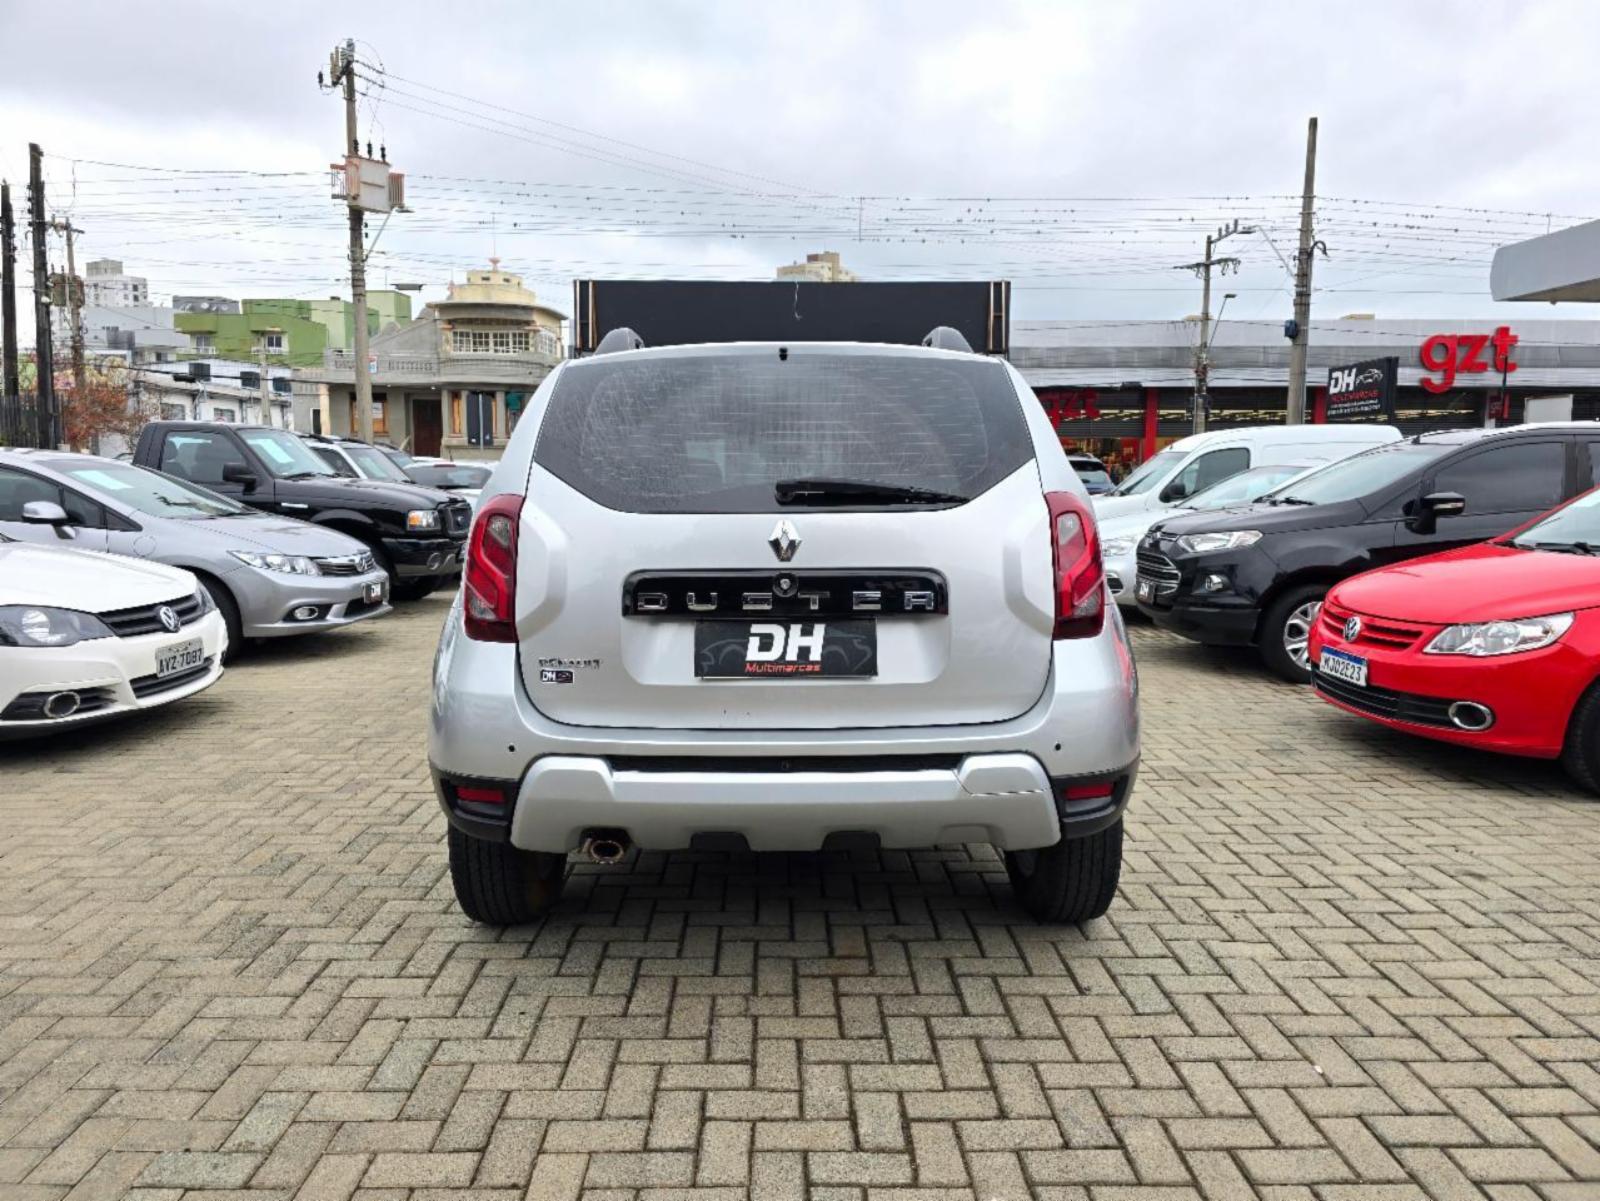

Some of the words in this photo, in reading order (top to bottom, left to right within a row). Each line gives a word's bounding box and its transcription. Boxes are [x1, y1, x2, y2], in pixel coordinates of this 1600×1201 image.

[1420, 326, 1519, 394] gzt
[1329, 367, 1357, 395] DH
[637, 591, 935, 611] DUSTER
[745, 623, 826, 661] DH
[744, 662, 822, 673] Multimarcas
